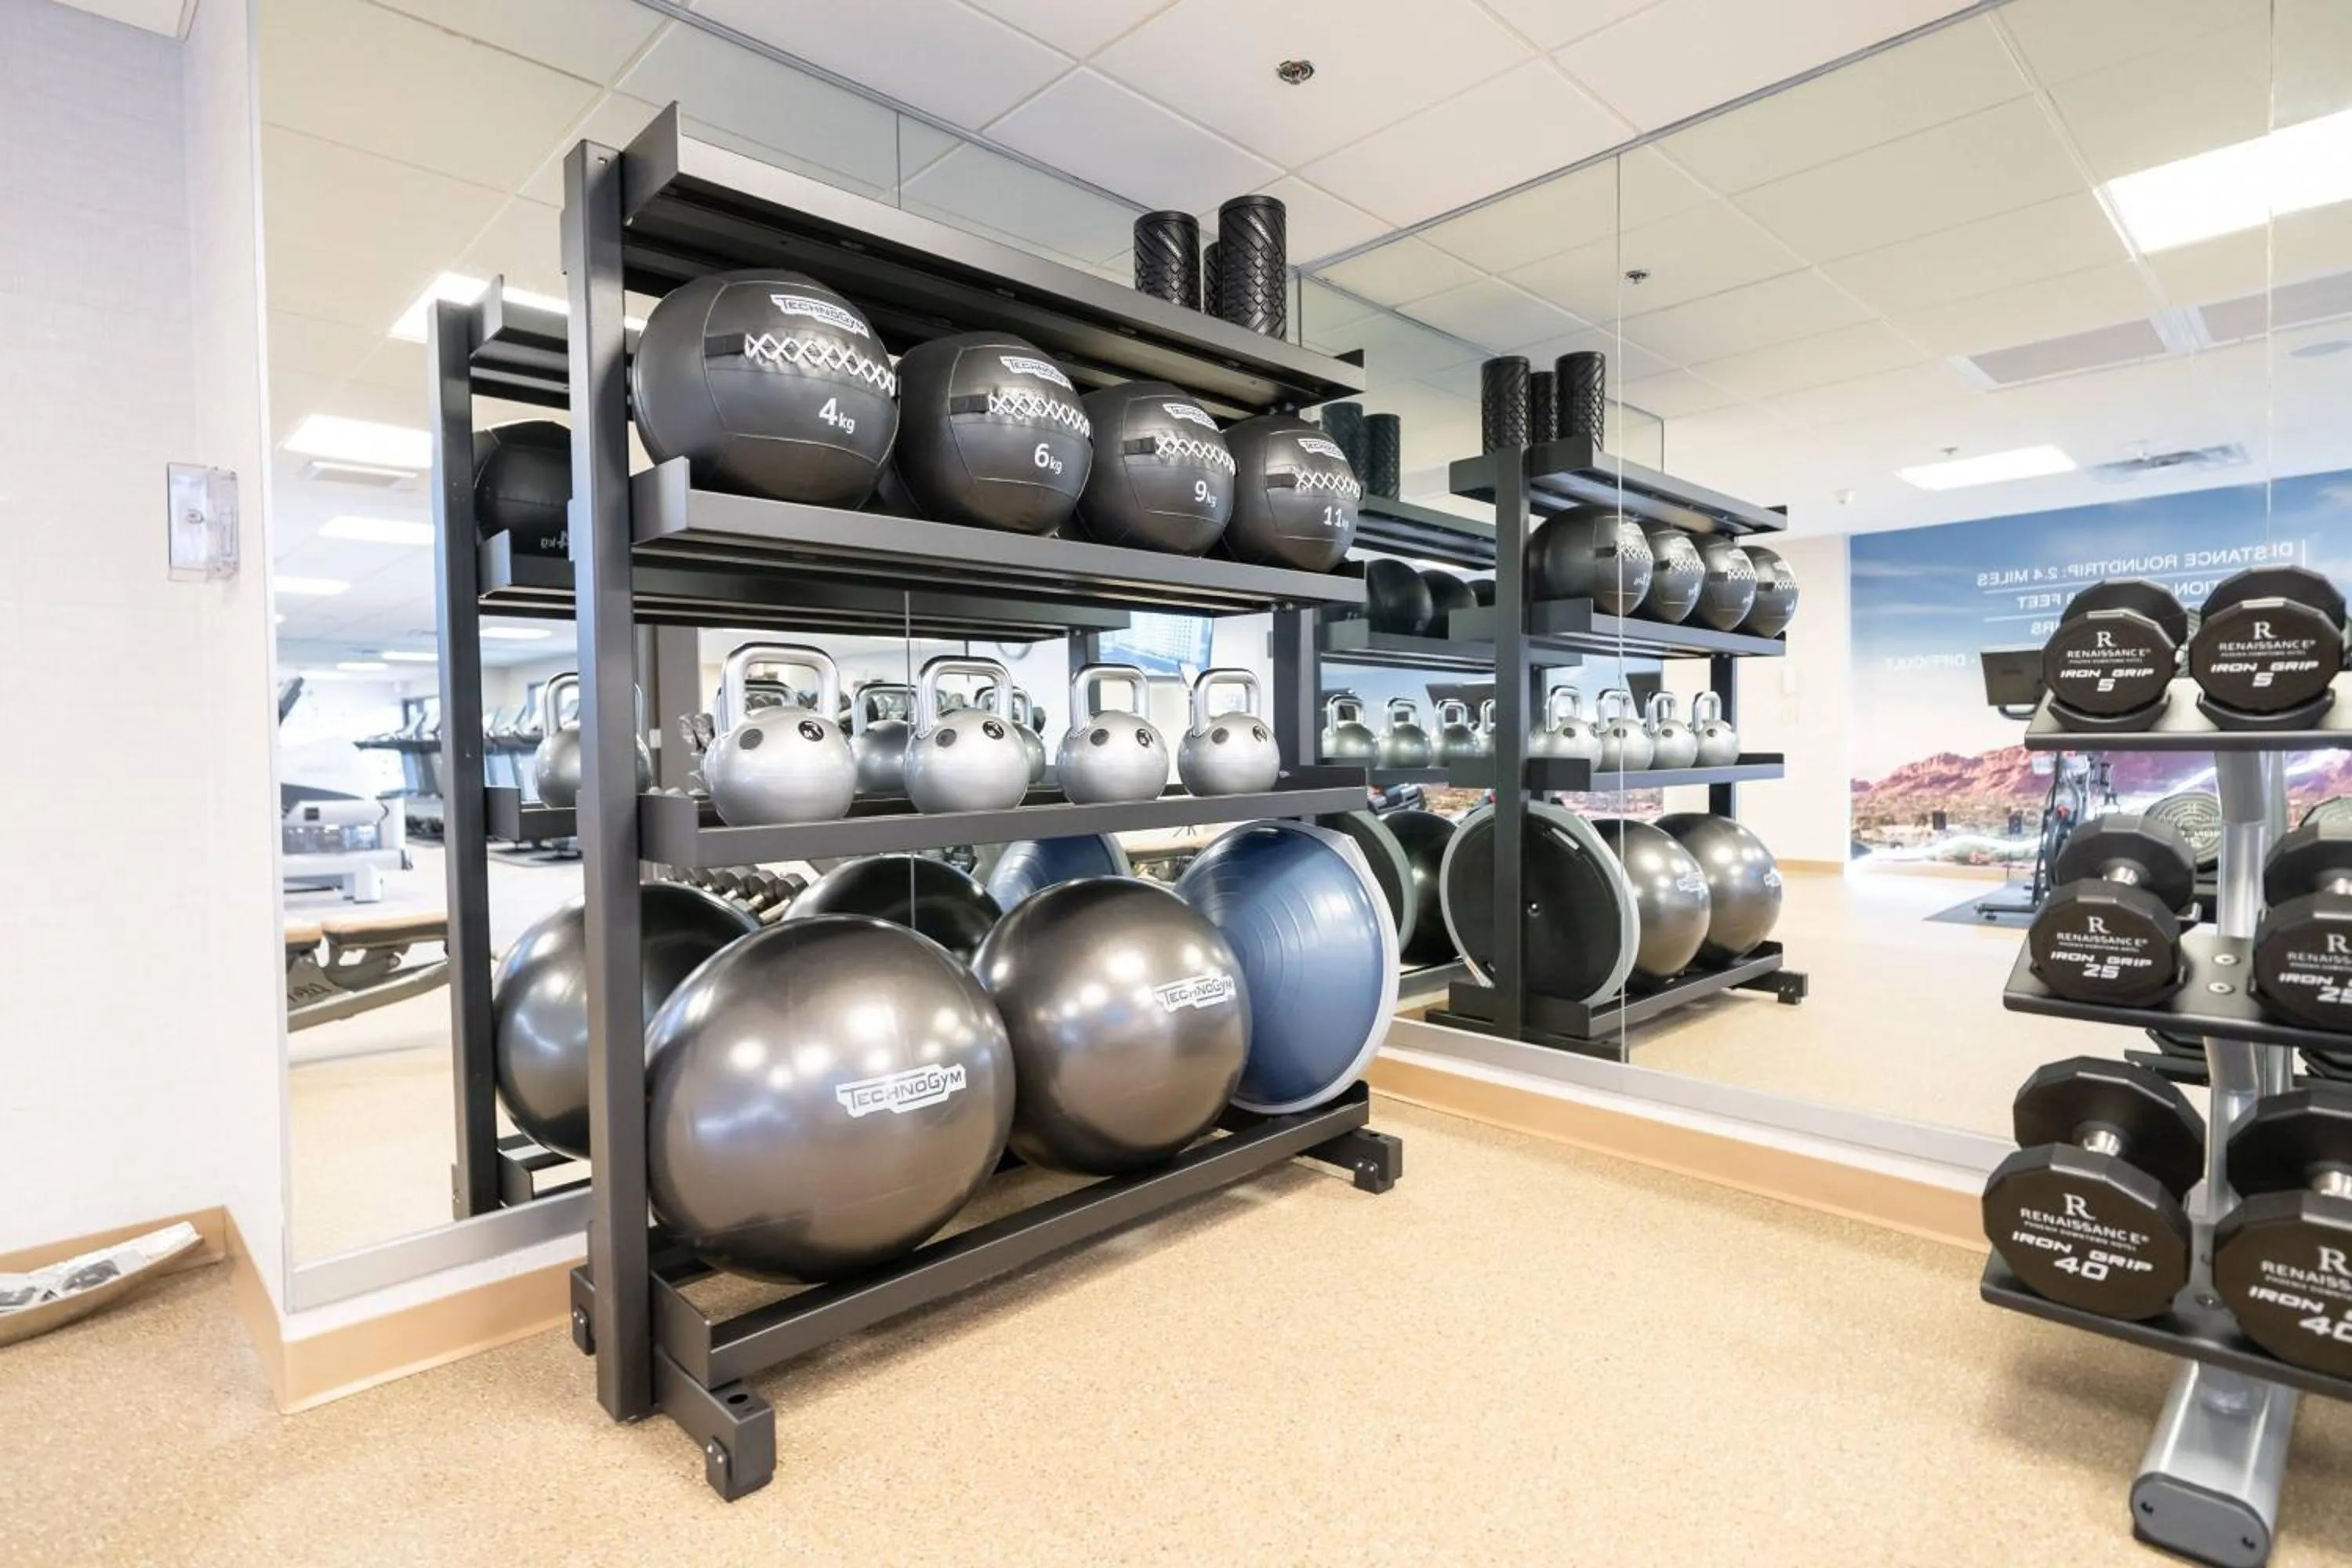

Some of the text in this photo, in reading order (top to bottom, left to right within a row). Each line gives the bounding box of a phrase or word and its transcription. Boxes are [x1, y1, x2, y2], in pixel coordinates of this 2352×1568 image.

[818, 397, 855, 434] 4kg
[1034, 443, 1062, 474] 6kg
[2096, 630, 2117, 648] R
[2253, 621, 2278, 641] R
[2066, 648, 2147, 659] RENAISSANCE
[2218, 639, 2311, 652] RENAISSANCE
[2060, 667, 2155, 678] IRON GRIP
[2210, 660, 2319, 673] IRON GRIP
[2096, 677, 2116, 692] 5
[2252, 671, 2274, 688] 5
[2086, 915, 2111, 935] R
[2056, 931, 2143, 948] RENAISSANCE
[2325, 933, 2352, 954] R
[2050, 950, 2153, 967] IRON GRIP
[2082, 962, 2120, 979] 25
[2278, 972, 2334, 985] IRON
[840, 1069, 963, 1110] TECHNOGYM
[2063, 1192, 2097, 1221] R
[2020, 1207, 2142, 1245] RENAISSANCE
[2012, 1230, 2072, 1254] IRON
[2089, 1249, 2154, 1272] GRIP
[2318, 1245, 2352, 1277] R
[2053, 1256, 2110, 1281] 40
[2248, 1284, 2325, 1314] IRON
